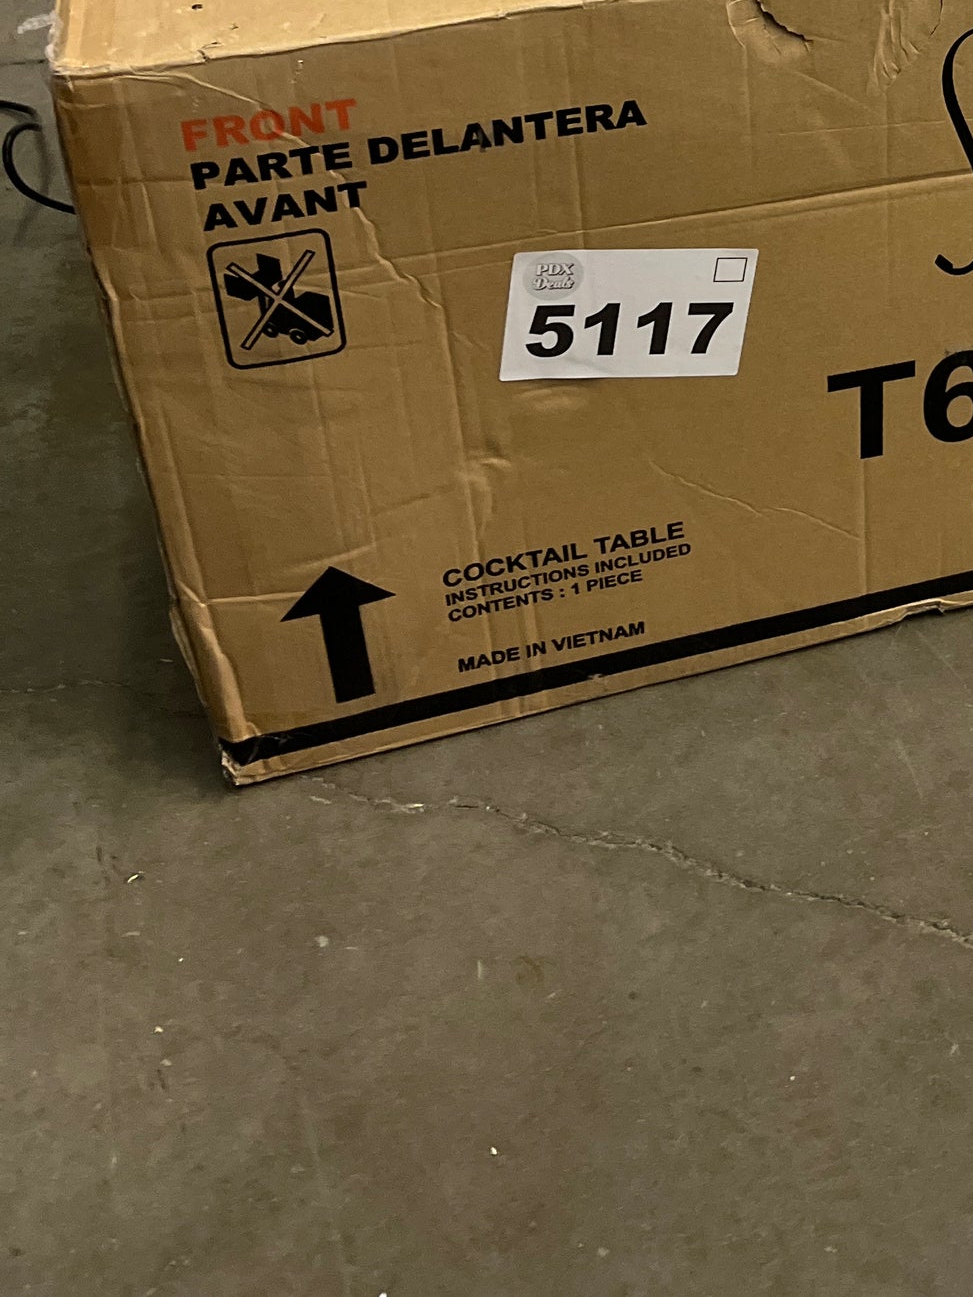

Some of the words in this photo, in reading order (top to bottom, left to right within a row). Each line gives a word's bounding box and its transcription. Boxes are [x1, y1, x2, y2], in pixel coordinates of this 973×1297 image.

[180, 98, 358, 152] FRONT
[189, 141, 353, 190] PARTE
[366, 99, 648, 166] DELANTERA
[203, 181, 368, 232] AVANT
[535, 262, 575, 277] PDX
[525, 302, 735, 358] 5117
[442, 543, 588, 587] COCKTAIL
[593, 521, 685, 554] TABLE
[445, 564, 590, 606] INSTRUCTIONS
[594, 543, 692, 574] INCLUDED
[448, 588, 554, 622] CONTENTS
[570, 582, 580, 595] 1
[587, 569, 643, 592] PIECE
[457, 647, 520, 673] MADE
[526, 641, 547, 658] IN
[551, 621, 645, 652] VIETNAM
